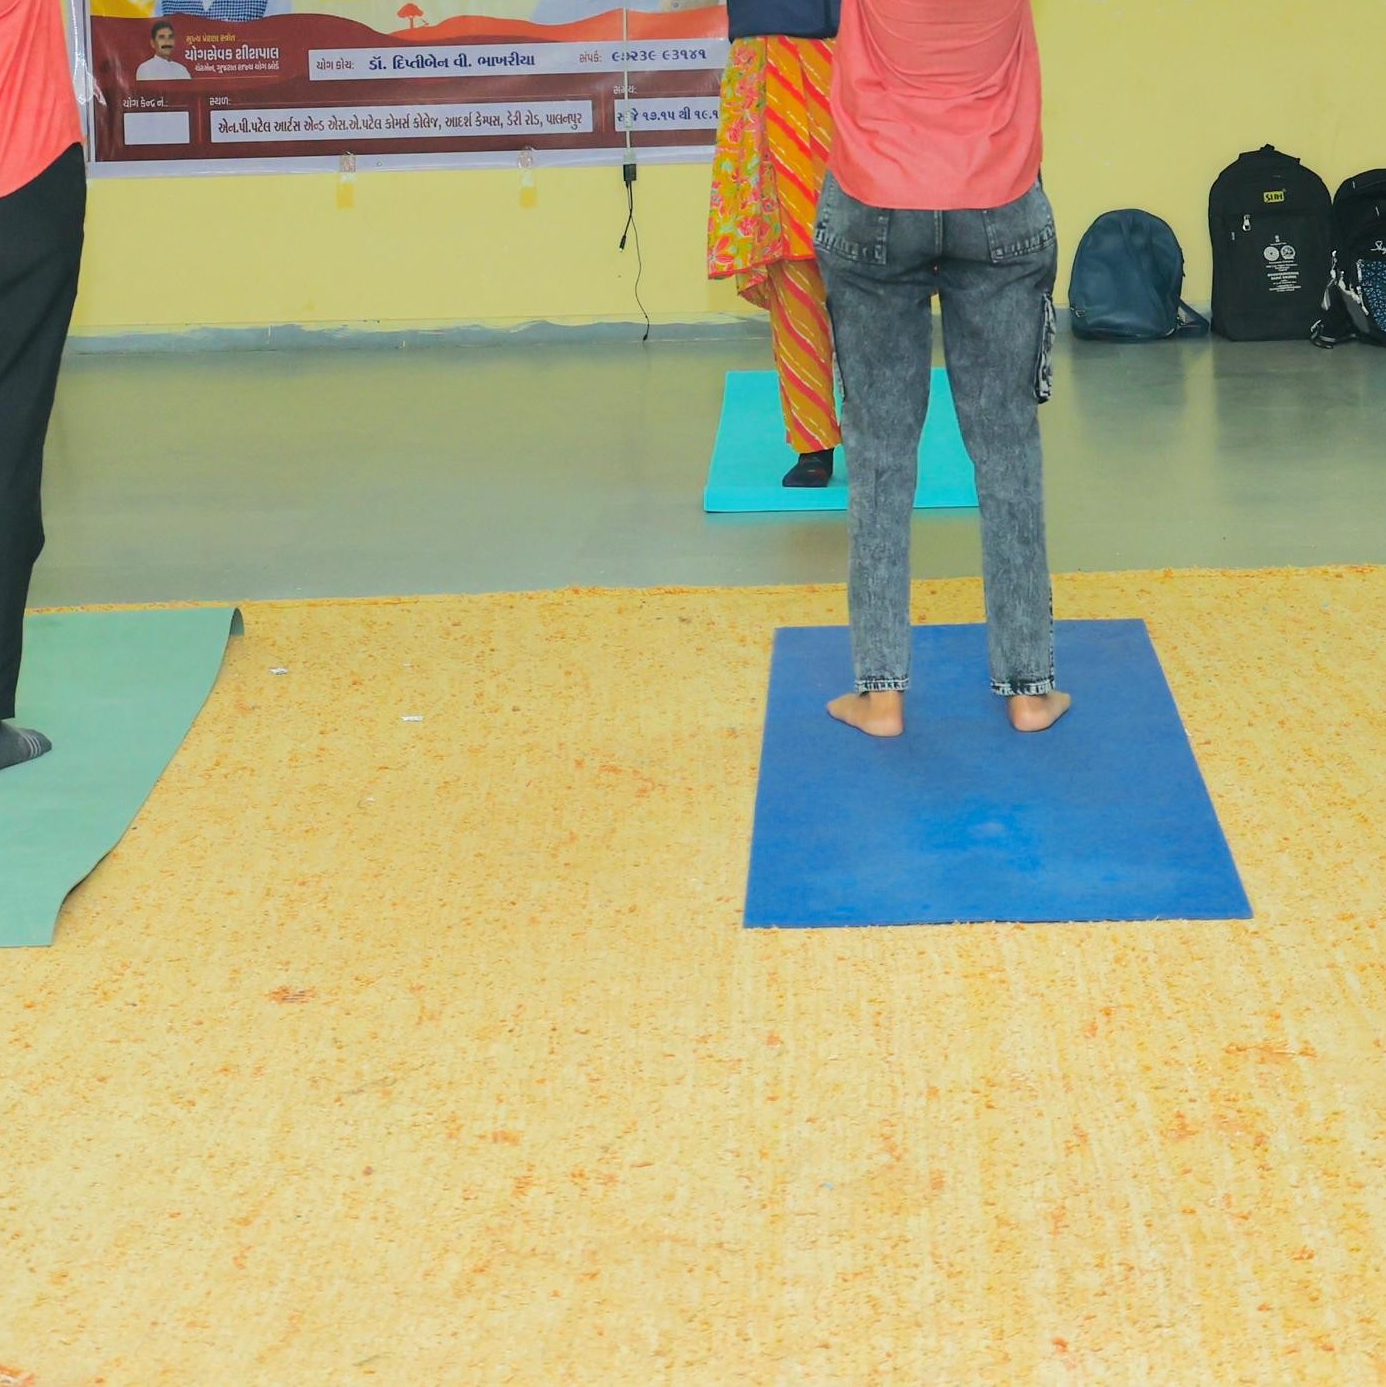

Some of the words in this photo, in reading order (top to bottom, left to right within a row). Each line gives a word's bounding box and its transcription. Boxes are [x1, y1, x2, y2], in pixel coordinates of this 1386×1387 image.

[185, 45, 234, 61] યોગસેવક
[235, 44, 279, 60] શીશપાલ
[662, 49, 707, 60] ૯૩૧૪૧
[254, 61, 267, 70] યોગ
[316, 58, 334, 70] યોગ
[369, 55, 387, 70] ડૉ.
[393, 53, 448, 70] દિપ્તીબેન
[453, 52, 472, 68] વી.
[477, 52, 535, 66] ભાખરીયા
[123, 97, 138, 108] યોગ
[140, 96, 156, 107] કેન્દ્ર
[209, 97, 231, 106] સ્થળ:
[642, 111, 675, 121] ૧૭.૧૫
[679, 106, 691, 120] થી
[695, 109, 719, 120] ૧૯.૧
[218, 118, 271, 134] એન.પી.પટેલ
[274, 117, 300, 132] આર્ટસ
[304, 116, 325, 132] એન્ડ
[328, 114, 382, 132] એસ.એ.પટેલ
[385, 112, 410, 129] કોમર્સ
[413, 113, 441, 130] કોલેજ,
[445, 112, 472, 128] આદર્શ
[475, 112, 503, 128] કેમ્પસ,
[507, 110, 522, 126] ડેરી
[525, 111, 543, 127] રોડ,
[546, 112, 582, 130] પાલનપુર
